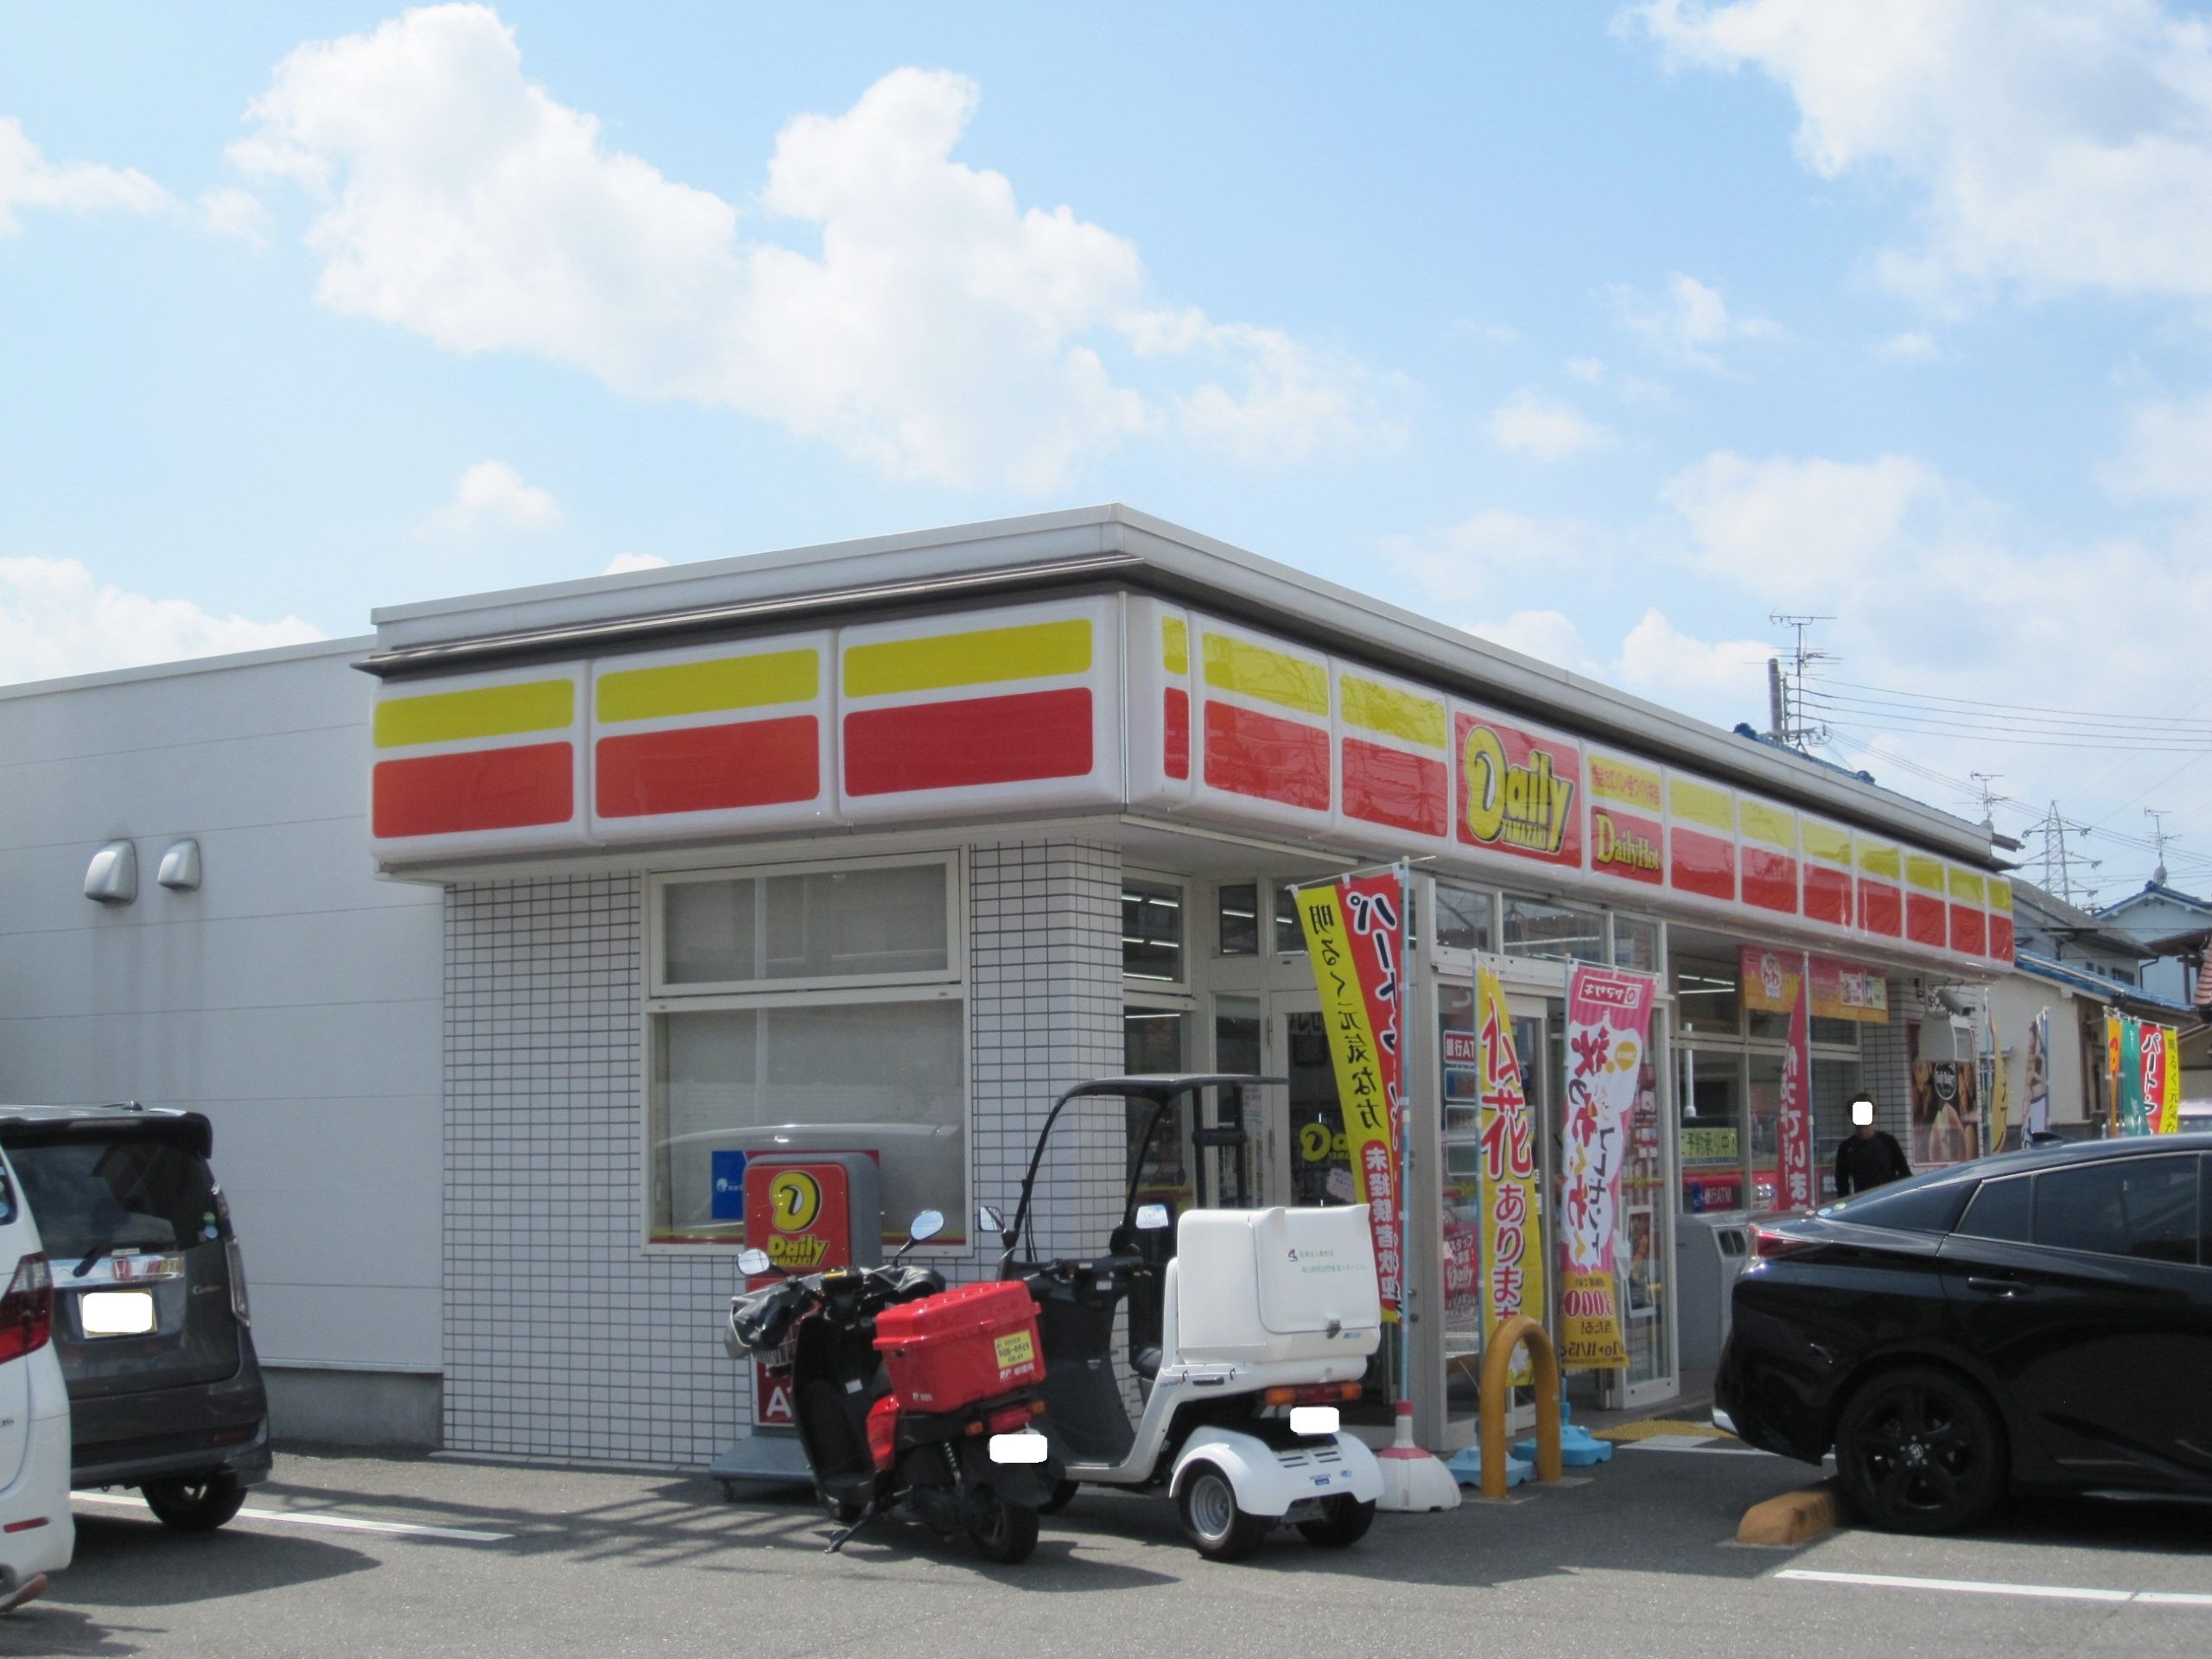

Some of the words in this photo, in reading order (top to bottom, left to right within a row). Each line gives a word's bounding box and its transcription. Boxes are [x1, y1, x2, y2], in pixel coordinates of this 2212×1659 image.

[1464, 725, 1574, 853] Daily
[1446, 1039, 1475, 1058] 銀行AT
[768, 1235, 830, 1265] Daily
